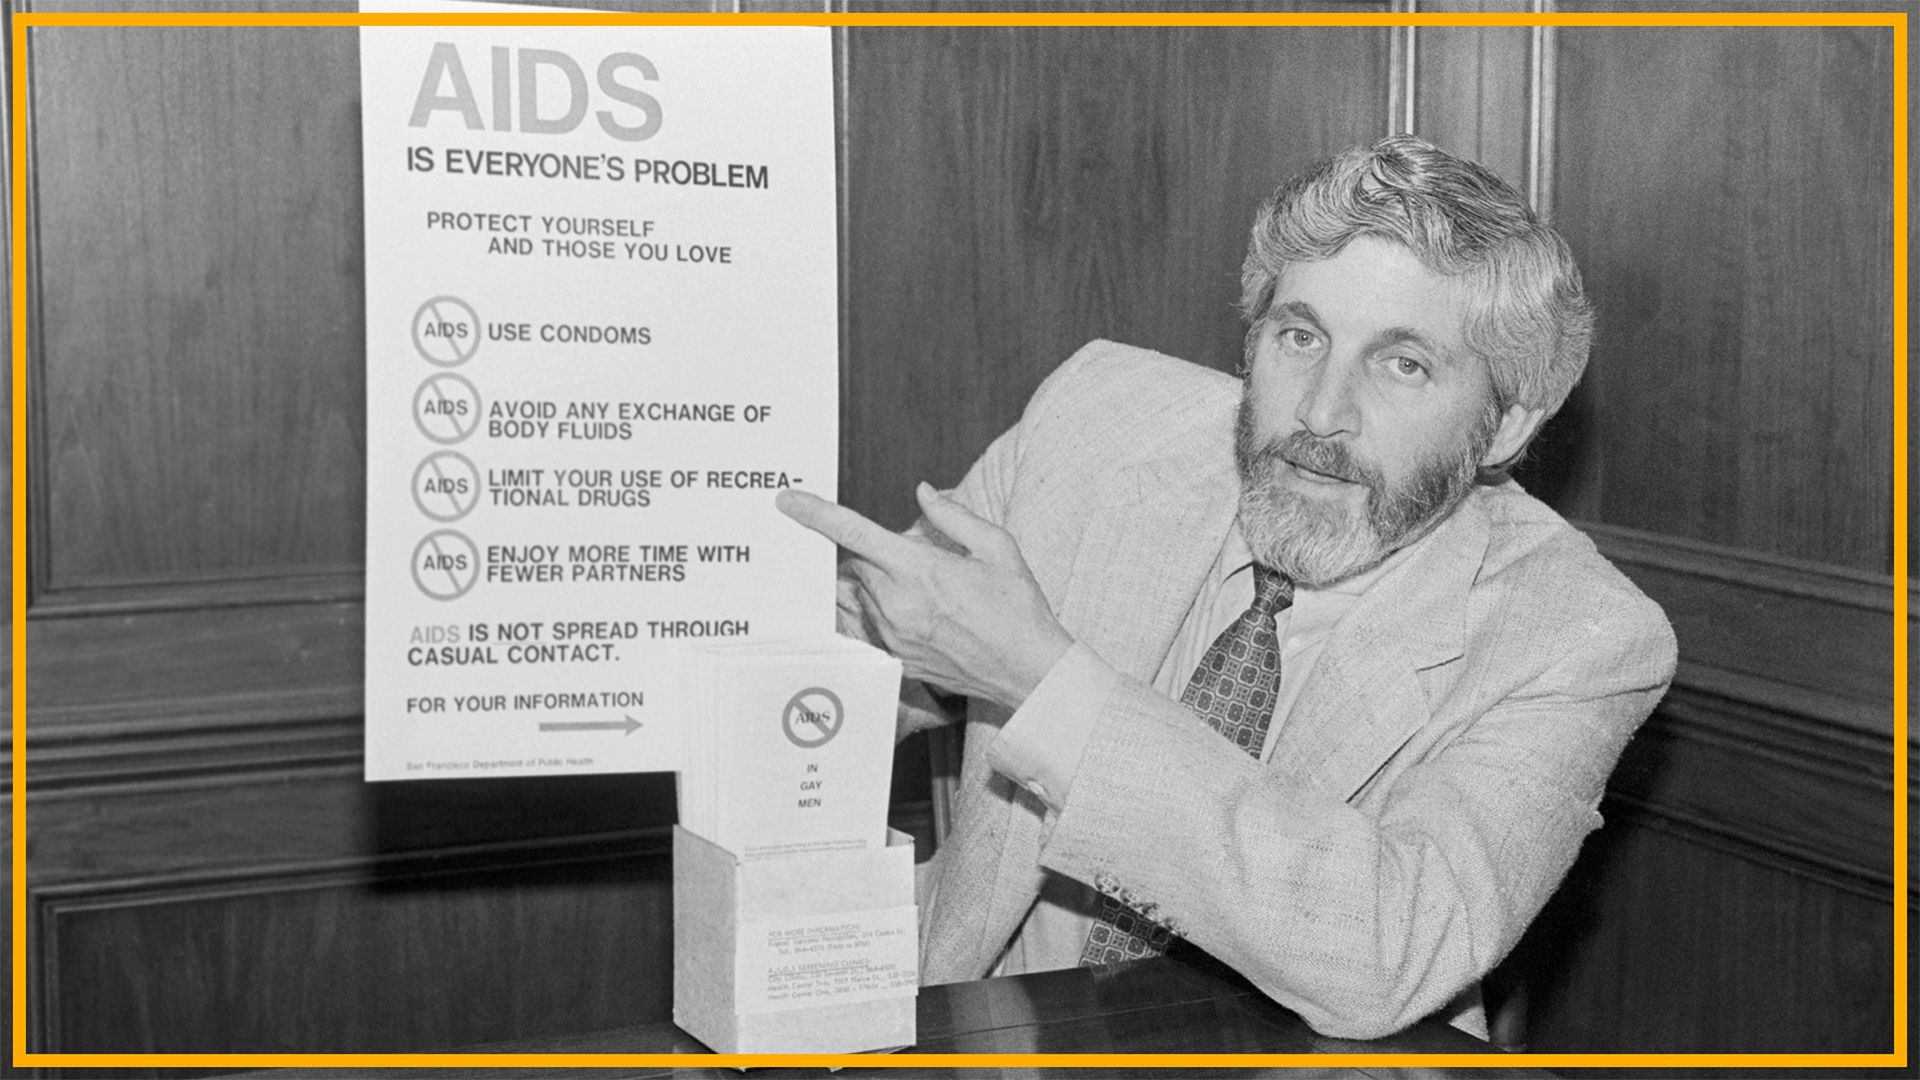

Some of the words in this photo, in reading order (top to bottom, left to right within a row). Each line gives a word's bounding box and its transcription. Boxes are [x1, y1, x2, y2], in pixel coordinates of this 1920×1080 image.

[408, 41, 663, 142] AIDS
[407, 146, 434, 172] IS
[446, 148, 625, 181] EVERYONE'S
[635, 159, 769, 189] PROBLEM
[427, 211, 532, 233] PROTECT
[542, 217, 655, 237] YOURSELF
[488, 237, 533, 255] AND
[542, 239, 616, 259] THOSE
[624, 243, 669, 261] YOU
[676, 245, 731, 264] LOVE
[424, 322, 468, 339] AIDS
[488, 323, 531, 341] USE
[540, 324, 652, 345] CONDOMS
[424, 400, 468, 416] AIDS
[489, 401, 556, 419] AVOID
[566, 402, 610, 421] ANY
[619, 403, 735, 422] EXCHANGE
[744, 406, 772, 423] OF
[488, 420, 550, 439] BODY
[557, 422, 633, 440] FLUIDS
[424, 478, 469, 494] AIDS
[488, 469, 545, 487] LIMIT
[553, 470, 613, 488] YOUR
[621, 470, 662, 488] USE
[670, 471, 699, 489] OF
[707, 472, 803, 489] RECREA-
[490, 489, 570, 507] TIONAL
[578, 489, 651, 507] DRUGS
[423, 555, 467, 571] AIDS
[487, 546, 560, 564] ENJOY
[568, 546, 630, 564] MORE
[639, 546, 689, 563] TIME
[696, 546, 750, 563] WITH
[487, 565, 564, 583] FEWER
[572, 564, 686, 582] PARTNERS
[410, 625, 461, 644] AIDS
[468, 624, 489, 642] IS
[498, 623, 544, 641] NOT
[552, 622, 639, 640] SPREAD
[647, 621, 750, 638] THROUGH
[407, 646, 499, 666] CASUAL
[507, 644, 620, 664] CONTACT.
[406, 697, 446, 714] FOR
[453, 695, 506, 712] YOUR
[514, 692, 644, 710] INFORMATION
[795, 711, 830, 725] AIDS
[406, 762, 423, 771] San
[427, 761, 470, 770] Francisco
[473, 760, 523, 769] Department
[526, 759, 535, 767] of
[539, 758, 563, 767] Public
[566, 757, 594, 766] Health
[807, 764, 818, 773] IN
[800, 781, 822, 791] GAY
[798, 798, 822, 808] MEN
